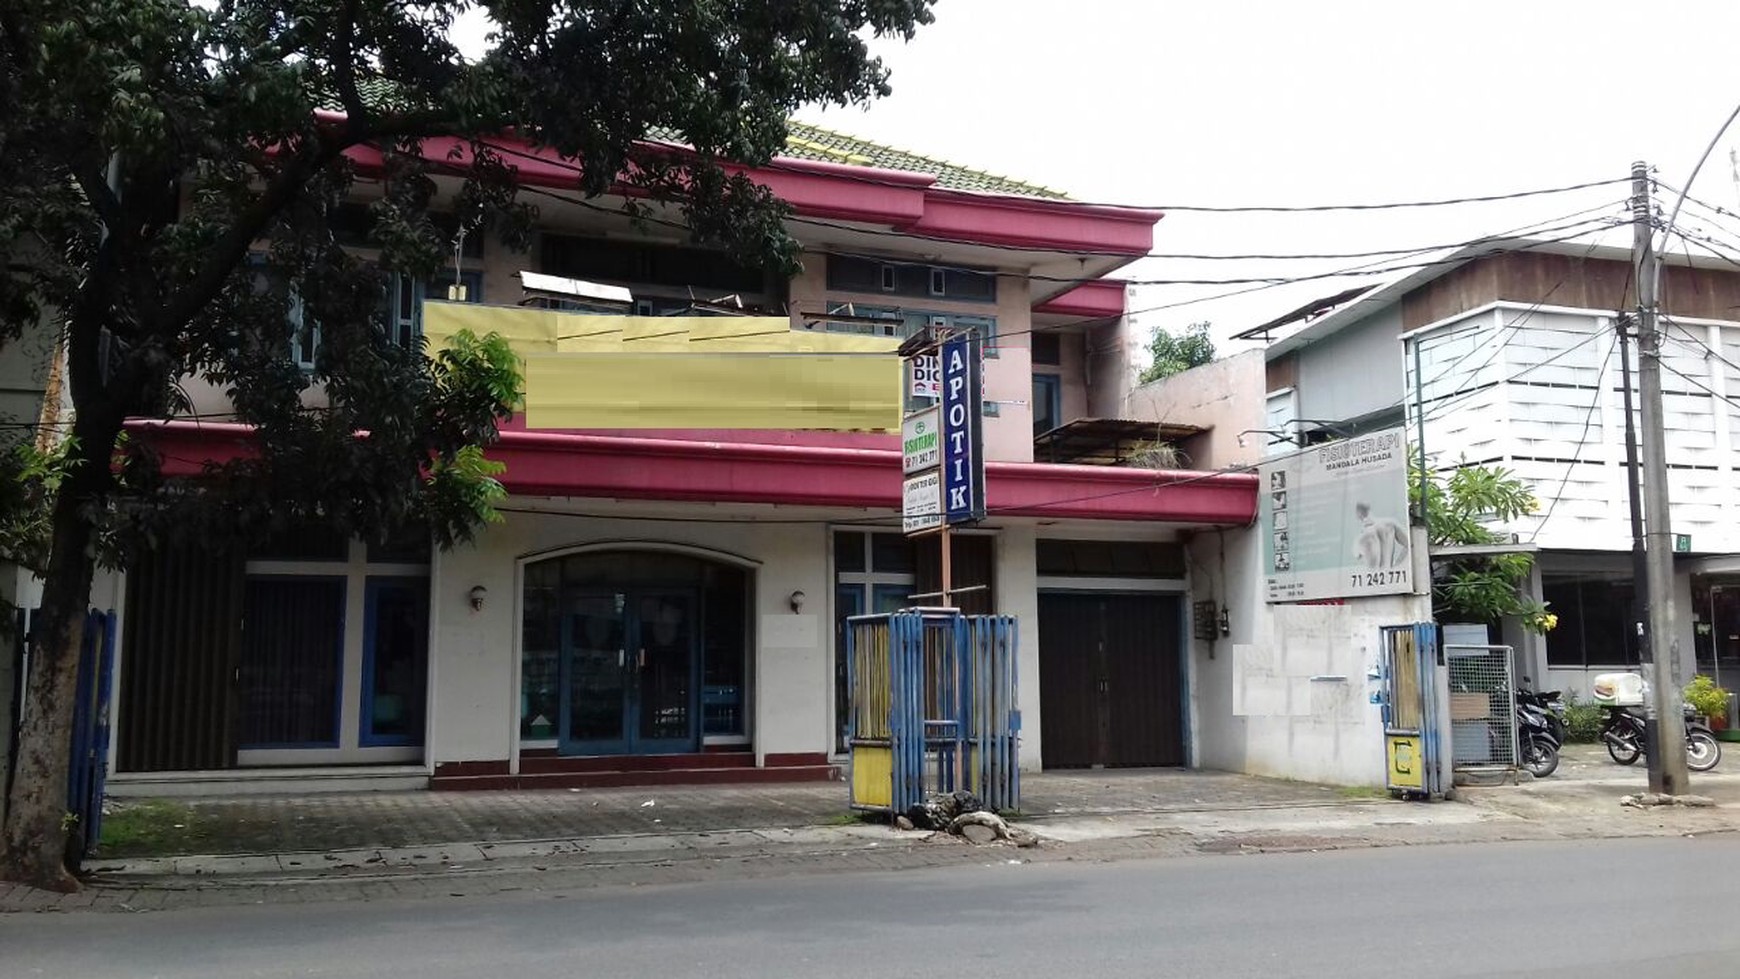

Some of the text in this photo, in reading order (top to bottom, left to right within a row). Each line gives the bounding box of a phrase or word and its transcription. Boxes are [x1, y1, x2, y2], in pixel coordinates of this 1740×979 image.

[948, 349, 967, 510] APOTIK
[1319, 433, 1400, 463] FISIOTERAPI
[1326, 459, 1360, 471] MANDALA
[1361, 453, 1393, 464] HUSADA
[1352, 570, 1407, 588] 71 242 771
